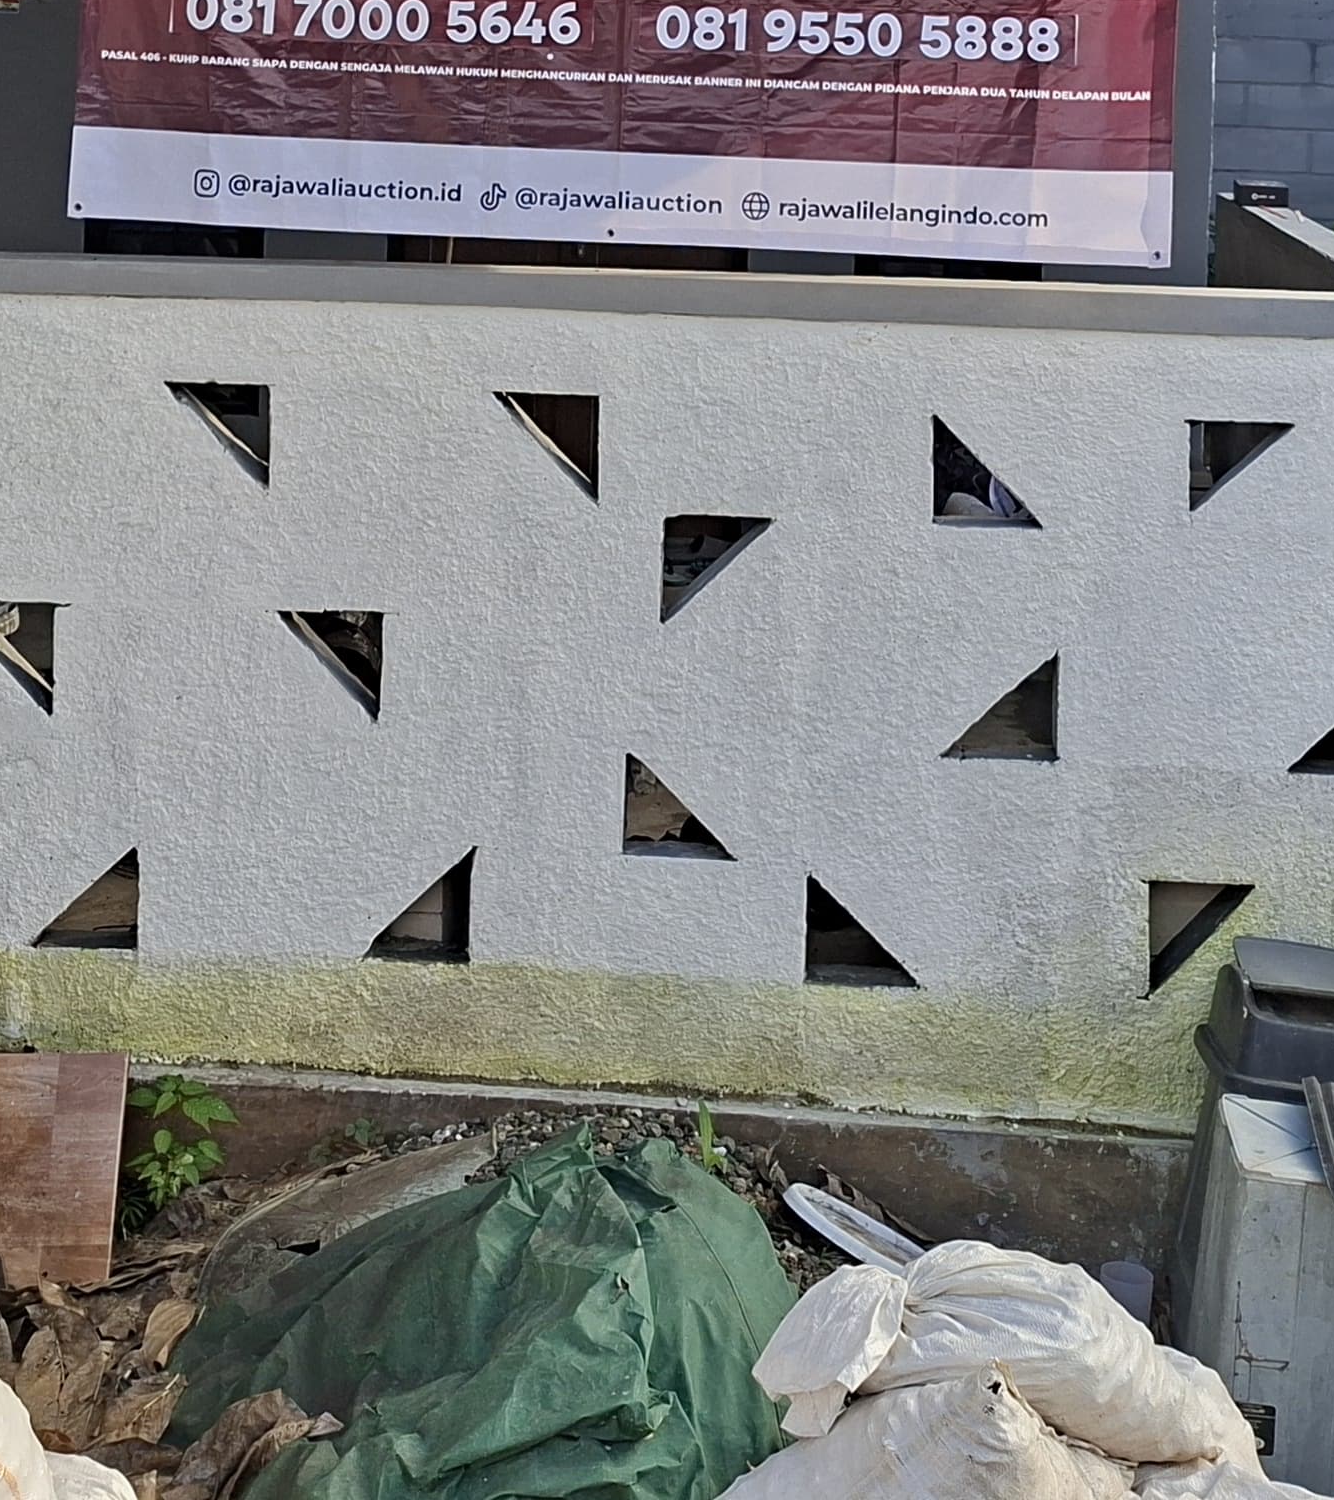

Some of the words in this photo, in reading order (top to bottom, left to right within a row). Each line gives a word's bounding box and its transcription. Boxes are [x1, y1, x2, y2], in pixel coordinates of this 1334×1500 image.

[445, 0, 582, 45] 5646
[655, 5, 747, 52] 081
[763, 8, 903, 58] 9550
[918, 14, 1060, 63] 5888
[101, 49, 138, 61] PASAL
[140, 52, 161, 63] 406
[169, 53, 200, 65] KUHP
[201, 54, 250, 68] BARANG
[252, 58, 287, 69] SIAPA
[289, 59, 338, 71] DENGAN
[340, 61, 392, 74] SENGAJA
[394, 63, 454, 77] MELAWAN
[456, 67, 498, 79] HUKUM
[500, 68, 605, 83] MENGHANCURKAN
[608, 72, 633, 83] DAN
[635, 73, 692, 86] MERUSAK
[694, 76, 743, 88] BANNER
[745, 78, 761, 88] INI
[763, 79, 820, 91] DIANCAM
[822, 81, 872, 93] DENGAN
[874, 83, 920, 95] PIDANA
[922, 85, 978, 97] PENJARA
[980, 87, 1007, 98] DUA
[1009, 88, 1049, 100] TAHUN
[1052, 90, 1109, 101] DELAPAN
[1111, 91, 1151, 102] BULAN
[228, 174, 462, 202] @rajawaliauction.id
[515, 188, 722, 214] @rajawaliauction
[779, 198, 1048, 228] rajawalilelangindo.com
